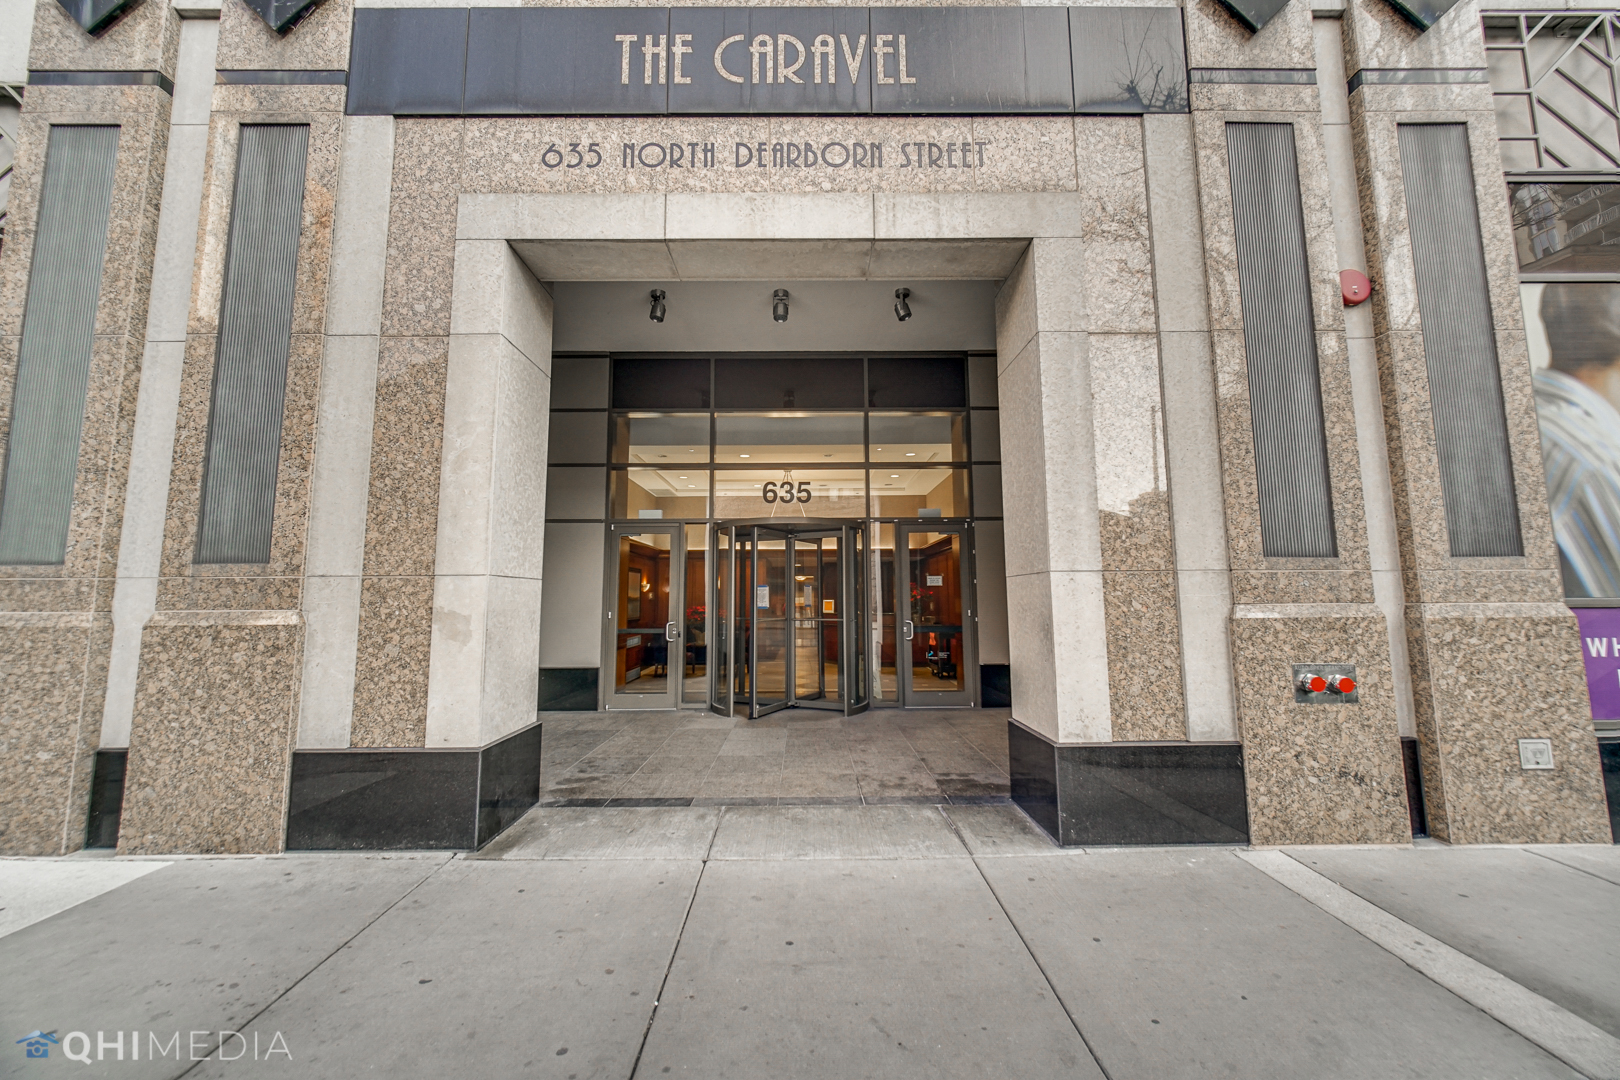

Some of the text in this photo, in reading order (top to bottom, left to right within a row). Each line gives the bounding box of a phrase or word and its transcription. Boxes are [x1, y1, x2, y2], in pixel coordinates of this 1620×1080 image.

[615, 34, 917, 85] THE CARAVEL
[541, 142, 987, 169] 635 NORTH DEARBORN STREET
[762, 481, 812, 504] 635
